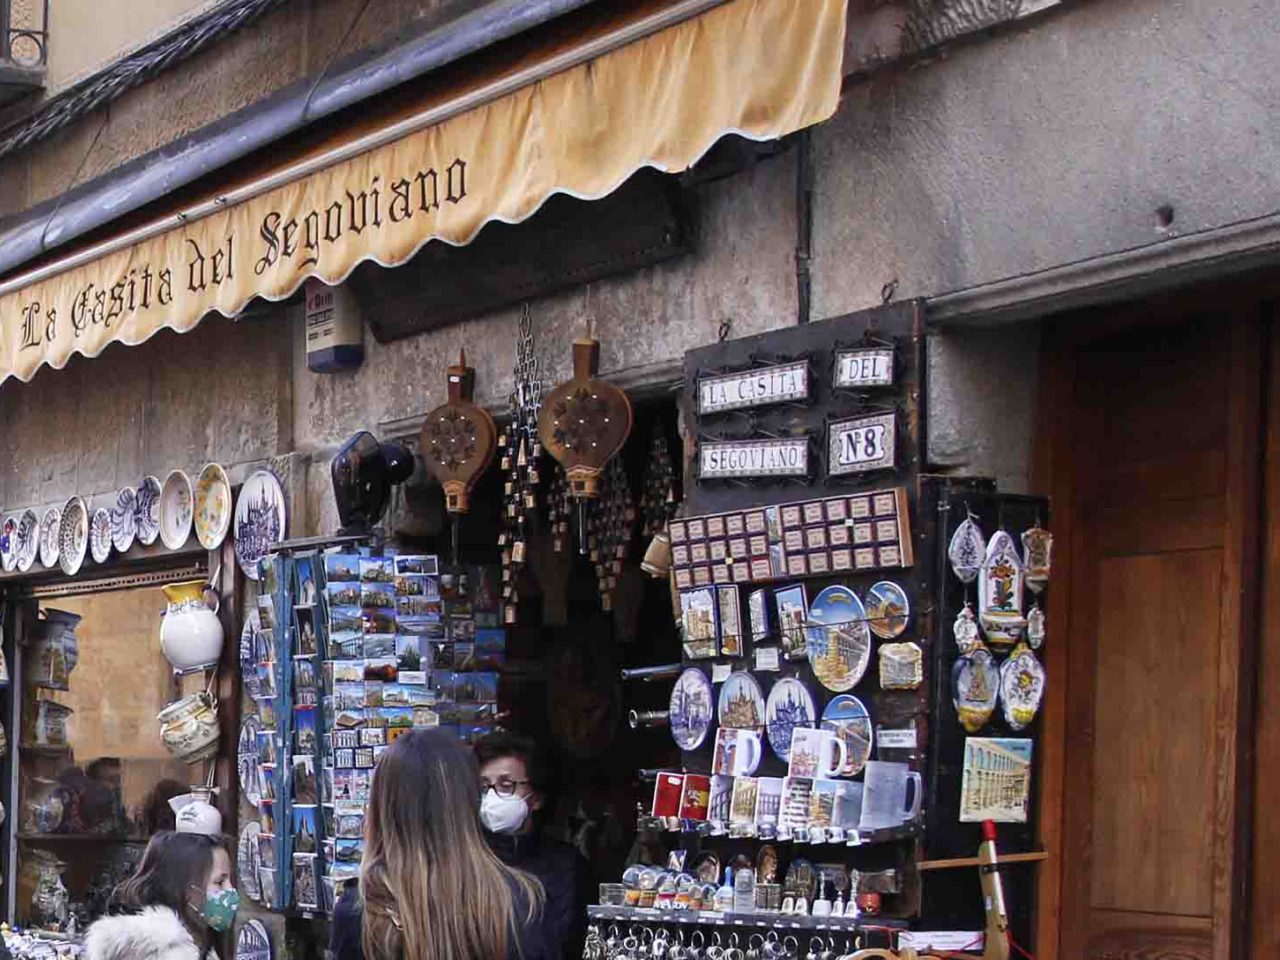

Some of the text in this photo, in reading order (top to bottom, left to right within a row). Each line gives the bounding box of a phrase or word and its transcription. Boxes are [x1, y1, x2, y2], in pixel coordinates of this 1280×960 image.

[20, 157, 468, 351] La Casita del Segoviano
[848, 357, 881, 380] DEL
[709, 372, 797, 405] LA CASITA
[709, 447, 798, 470] SEGOVIANO
